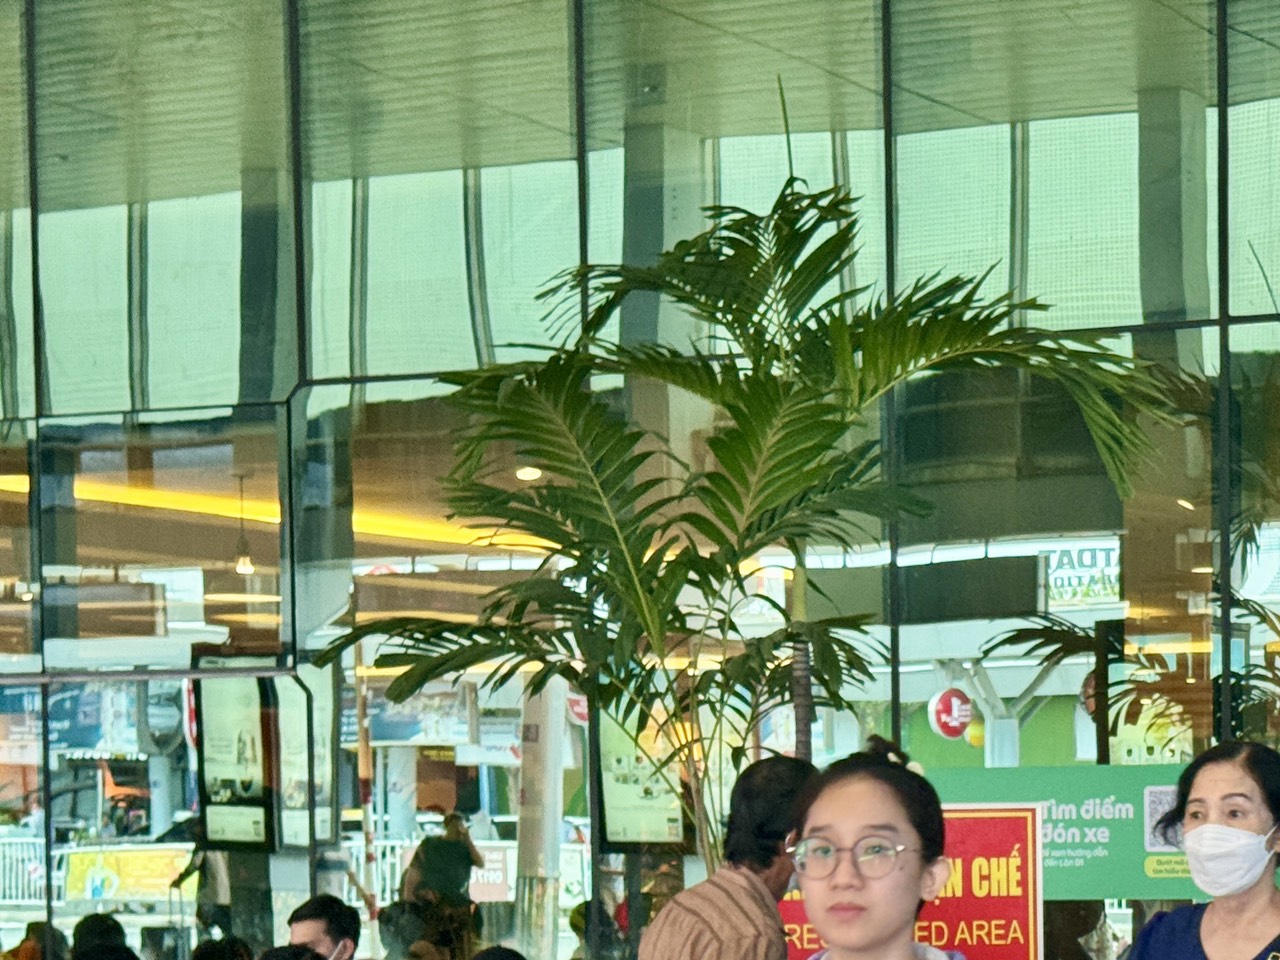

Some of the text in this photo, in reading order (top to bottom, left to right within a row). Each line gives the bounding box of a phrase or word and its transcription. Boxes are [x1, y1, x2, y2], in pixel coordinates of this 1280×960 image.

[1080, 795, 1134, 820] điểm
[1083, 826, 1110, 843] xe
[971, 843, 1023, 898] CHẾ
[954, 919, 1025, 946] AREA
